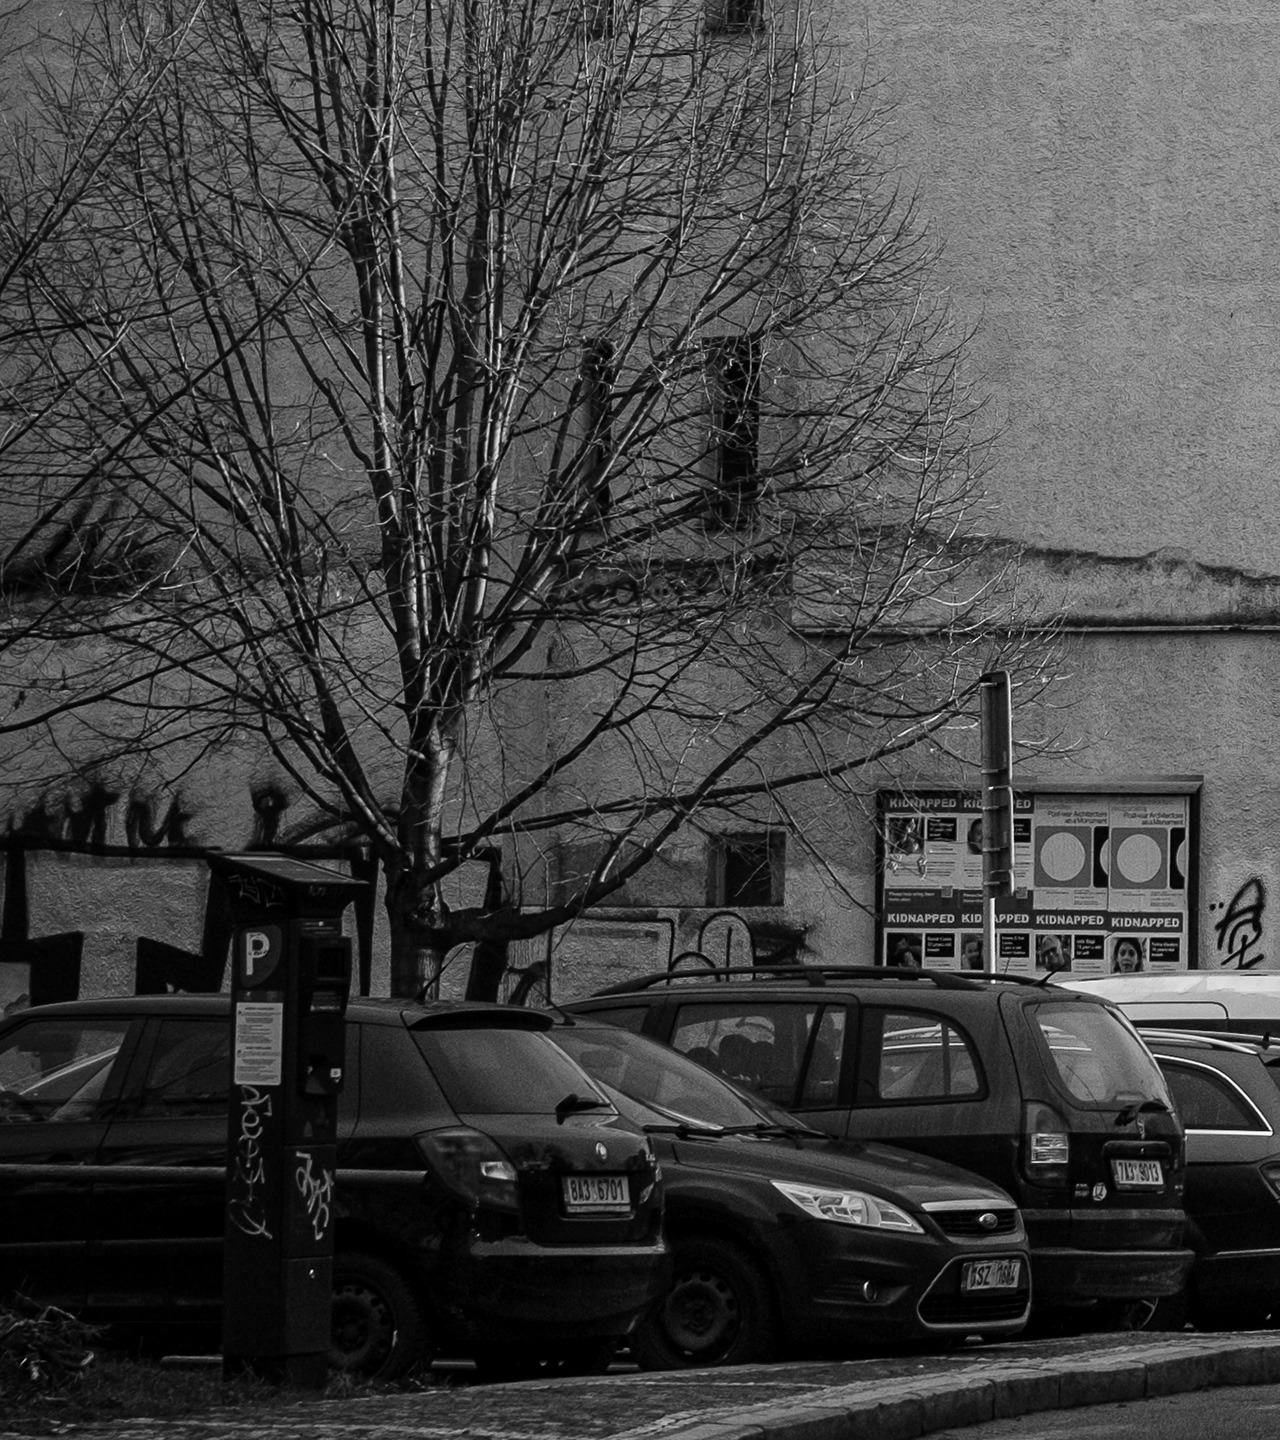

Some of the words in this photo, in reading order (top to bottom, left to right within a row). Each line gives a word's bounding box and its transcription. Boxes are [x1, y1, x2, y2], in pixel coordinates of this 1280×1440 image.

[889, 798, 957, 809] KIDNAPPED
[887, 913, 955, 923] KIDNAPPED
[961, 913, 1030, 924] KIDAPPED
[1036, 914, 1105, 925] KIDNAPPED
[1111, 917, 1180, 928] KIDNAPPED
[245, 932, 270, 976] P
[597, 1179, 625, 1202] 6701
